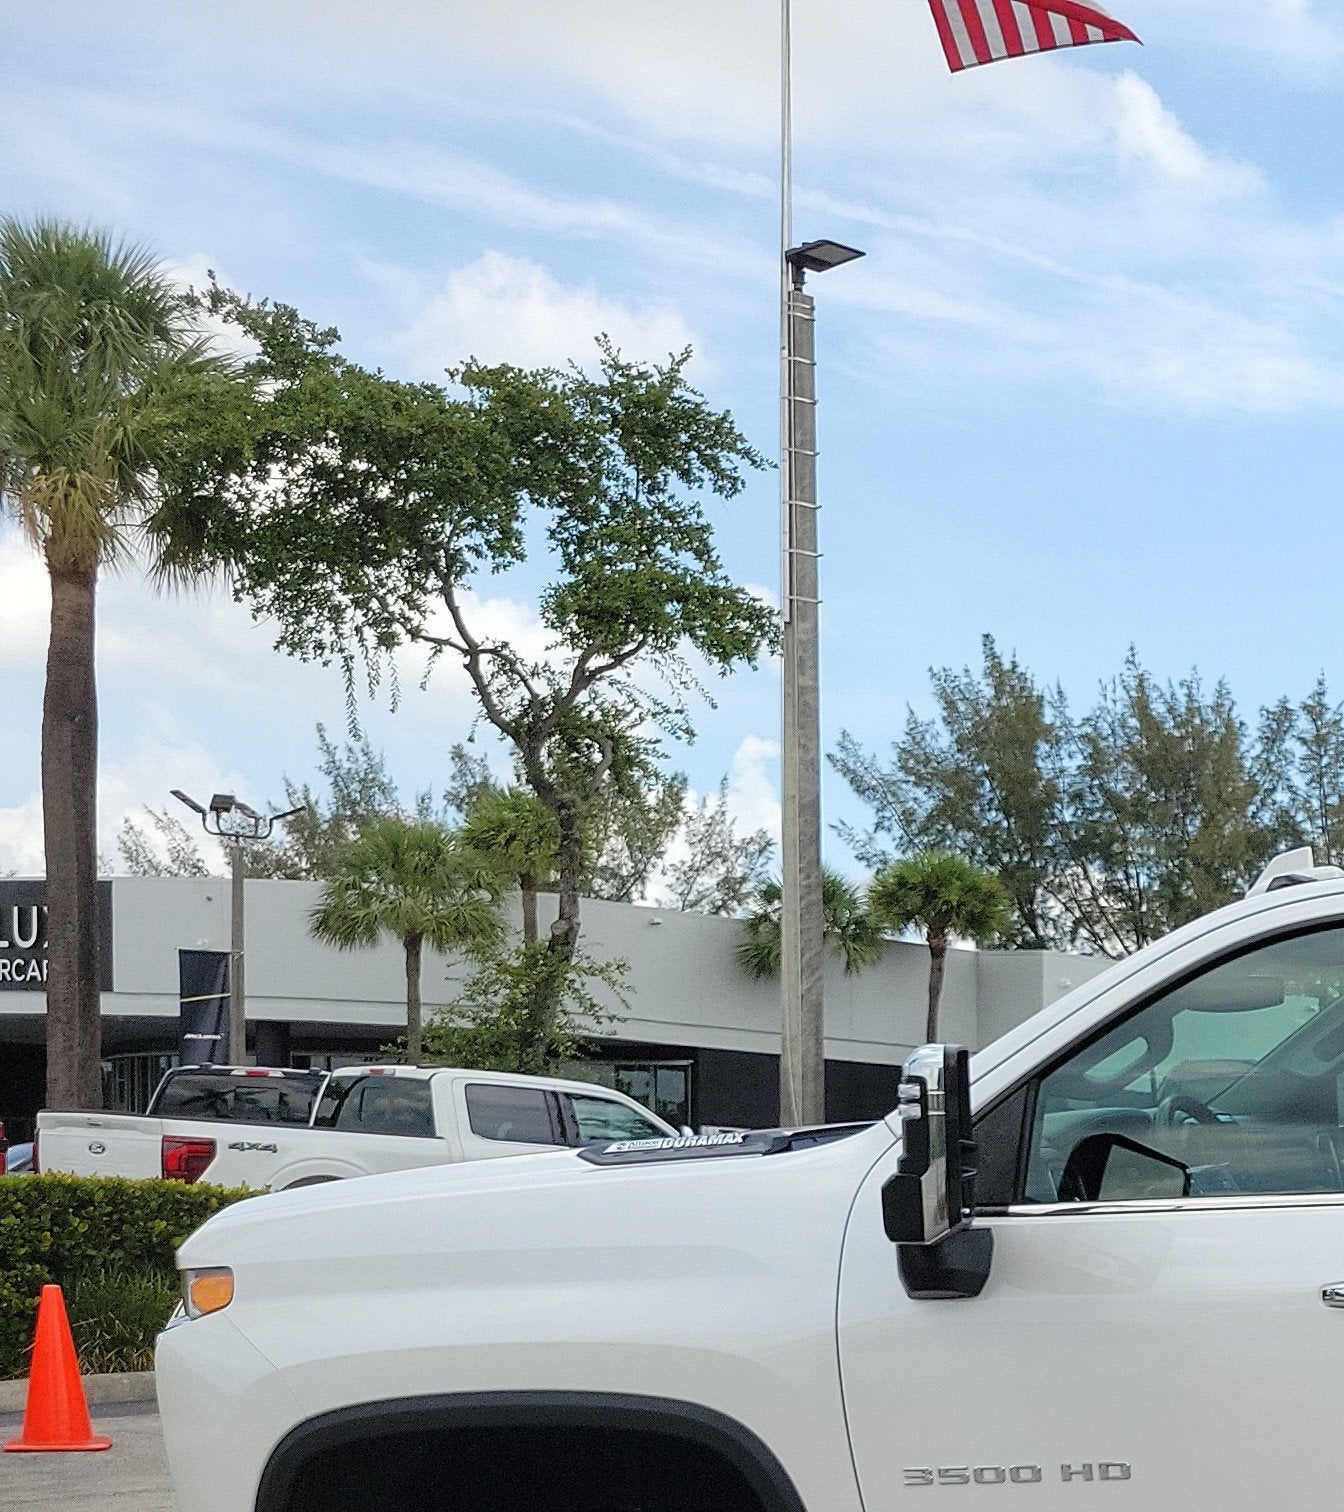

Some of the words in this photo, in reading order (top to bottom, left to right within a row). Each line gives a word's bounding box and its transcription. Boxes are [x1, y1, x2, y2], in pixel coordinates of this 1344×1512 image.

[661, 1133, 746, 1149] DURAMAX
[902, 1464, 1043, 1486] 3500
[1060, 1461, 1132, 1482] HD
